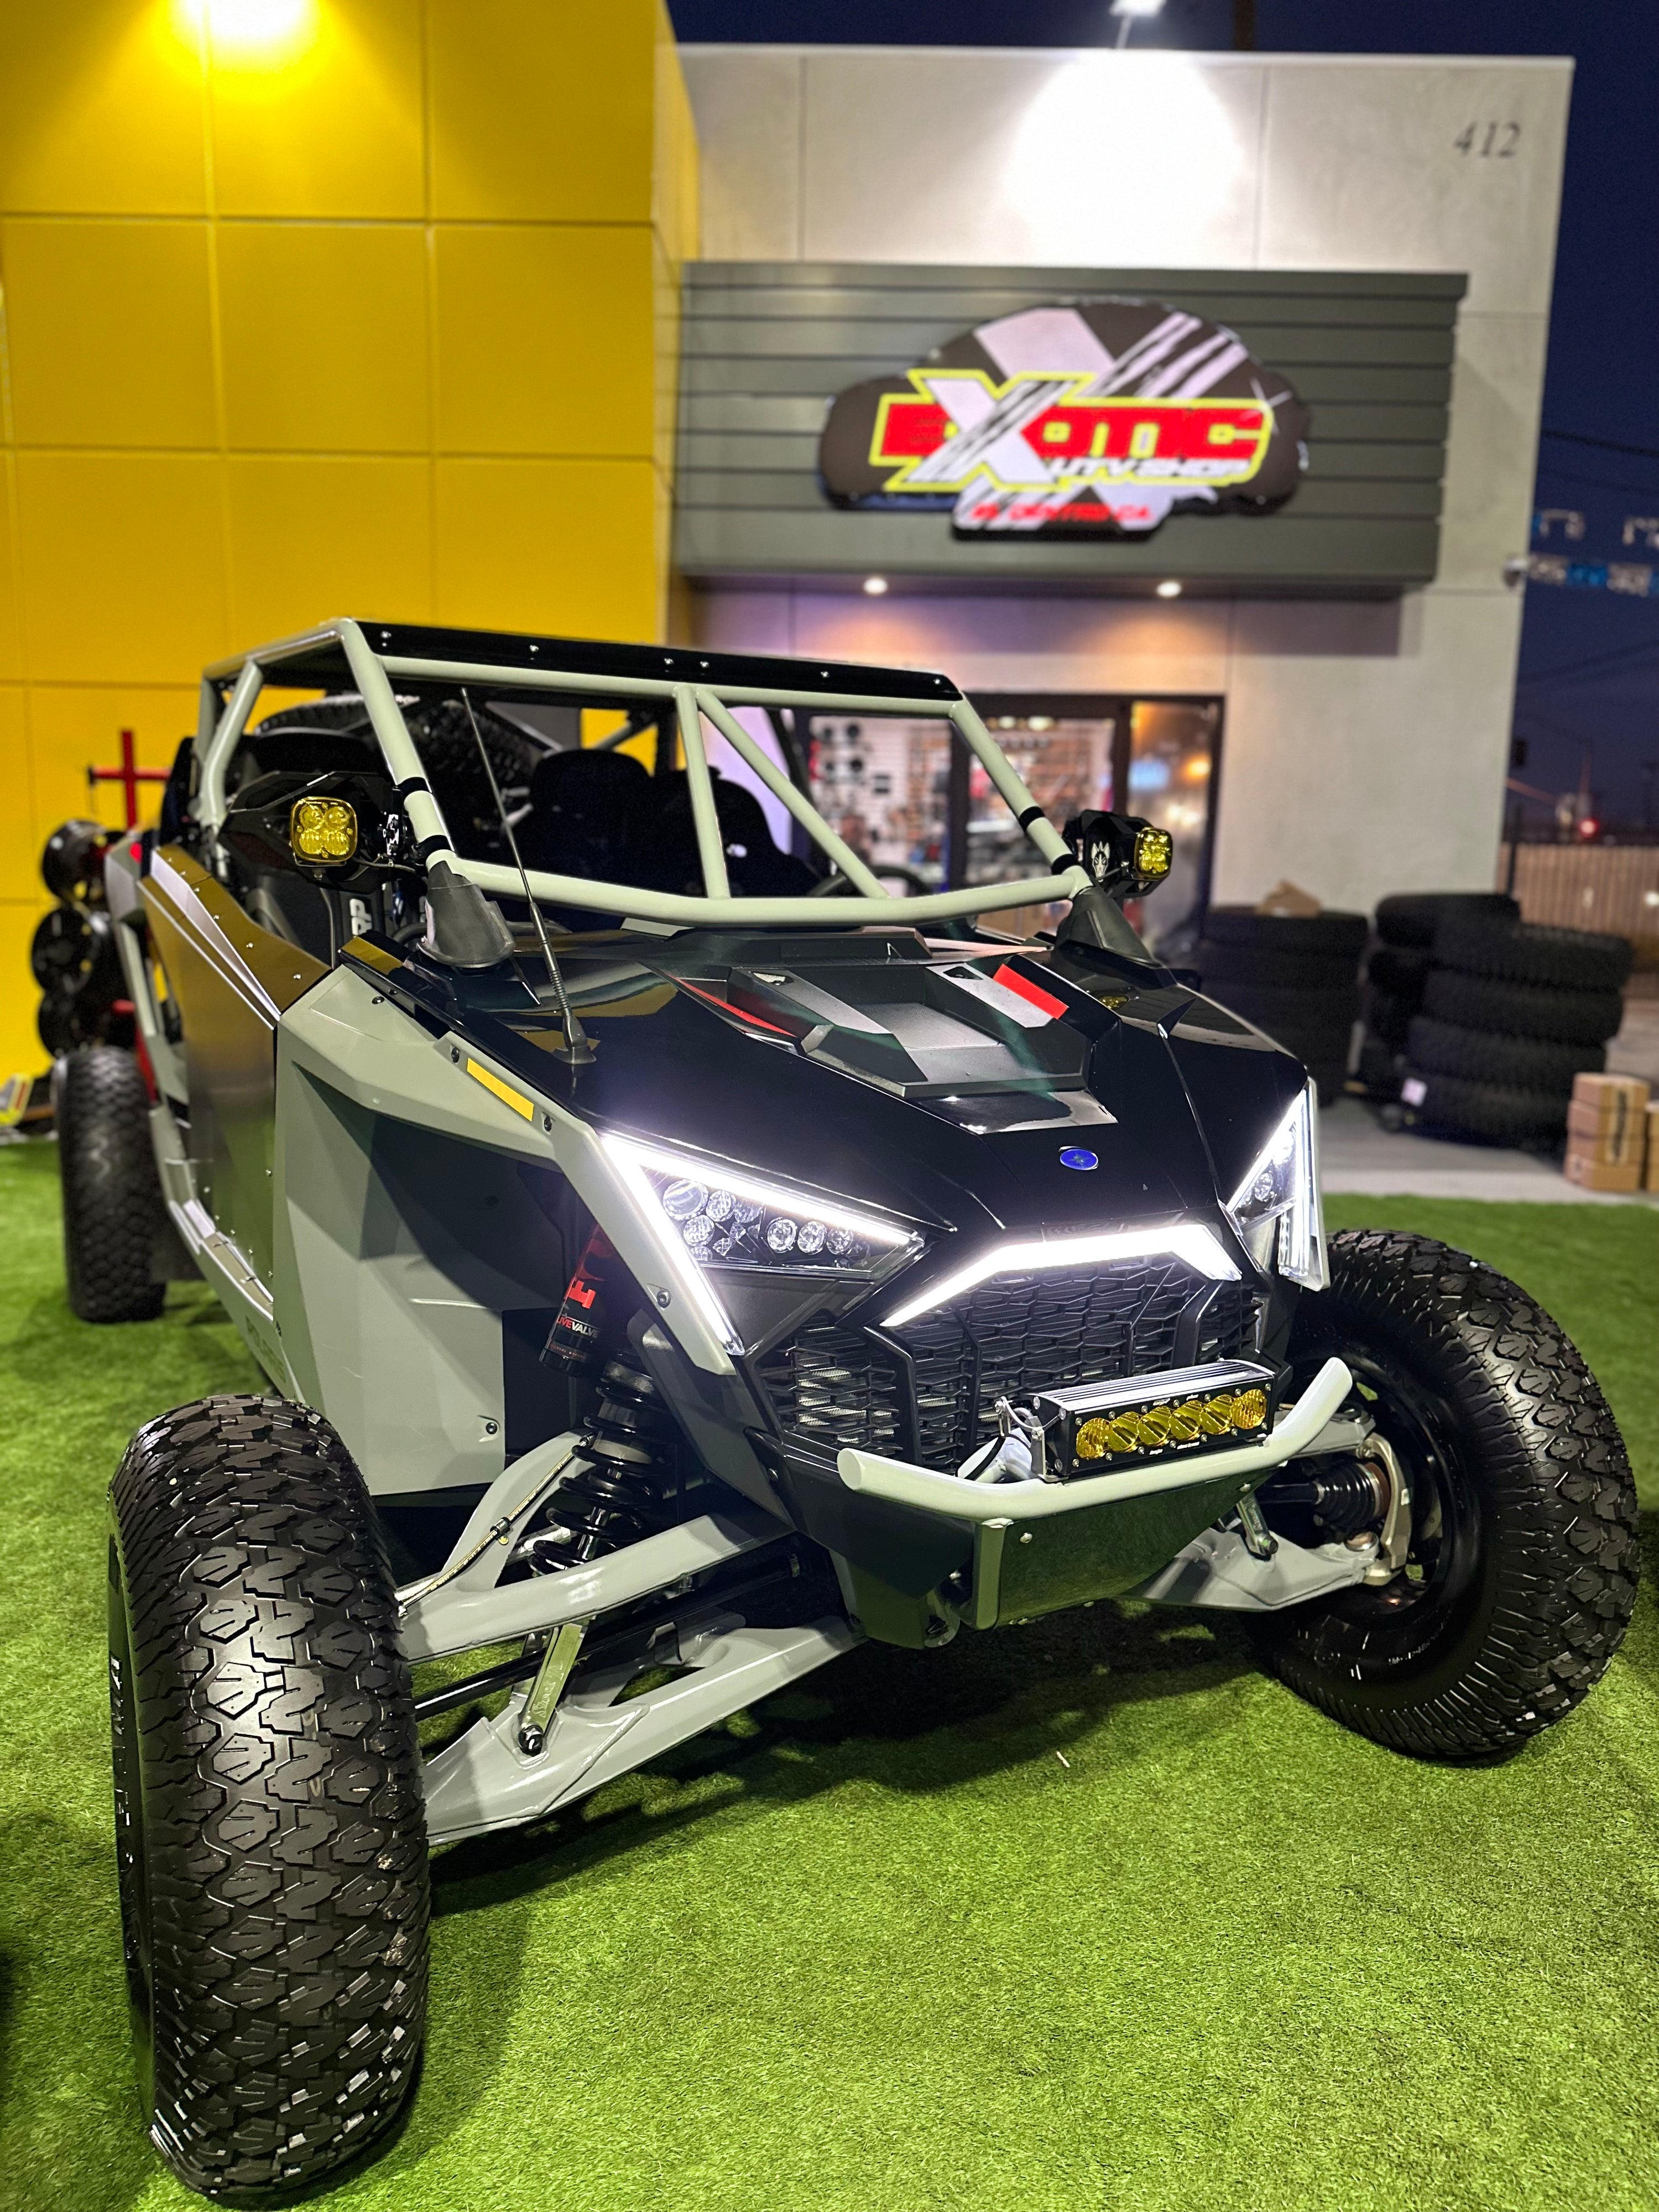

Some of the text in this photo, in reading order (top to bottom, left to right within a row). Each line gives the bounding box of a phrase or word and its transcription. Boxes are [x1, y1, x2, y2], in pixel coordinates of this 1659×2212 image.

[1452, 121, 1521, 158] 412
[874, 373, 1270, 488] EXOTIC
[1048, 458, 1252, 478] UTV SHOP
